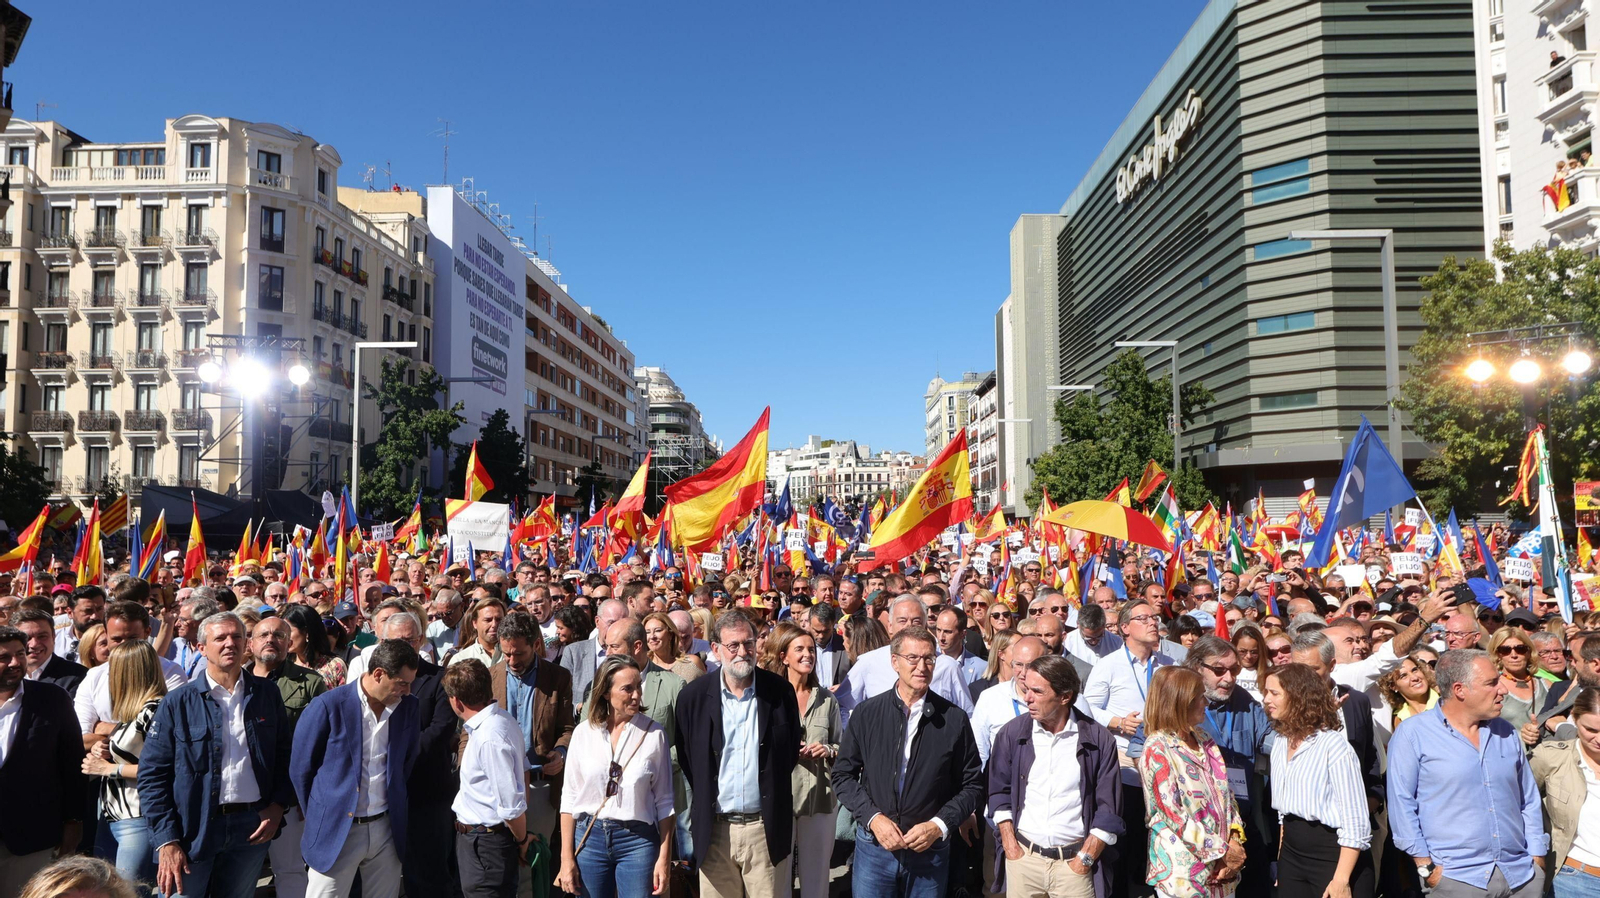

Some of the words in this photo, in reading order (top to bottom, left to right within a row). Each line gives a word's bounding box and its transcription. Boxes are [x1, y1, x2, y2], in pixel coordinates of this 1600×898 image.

[464, 242, 475, 265] PARA
[477, 233, 492, 259] LLEGAR
[493, 246, 504, 268] TARDE
[473, 341, 506, 374] finetwork
